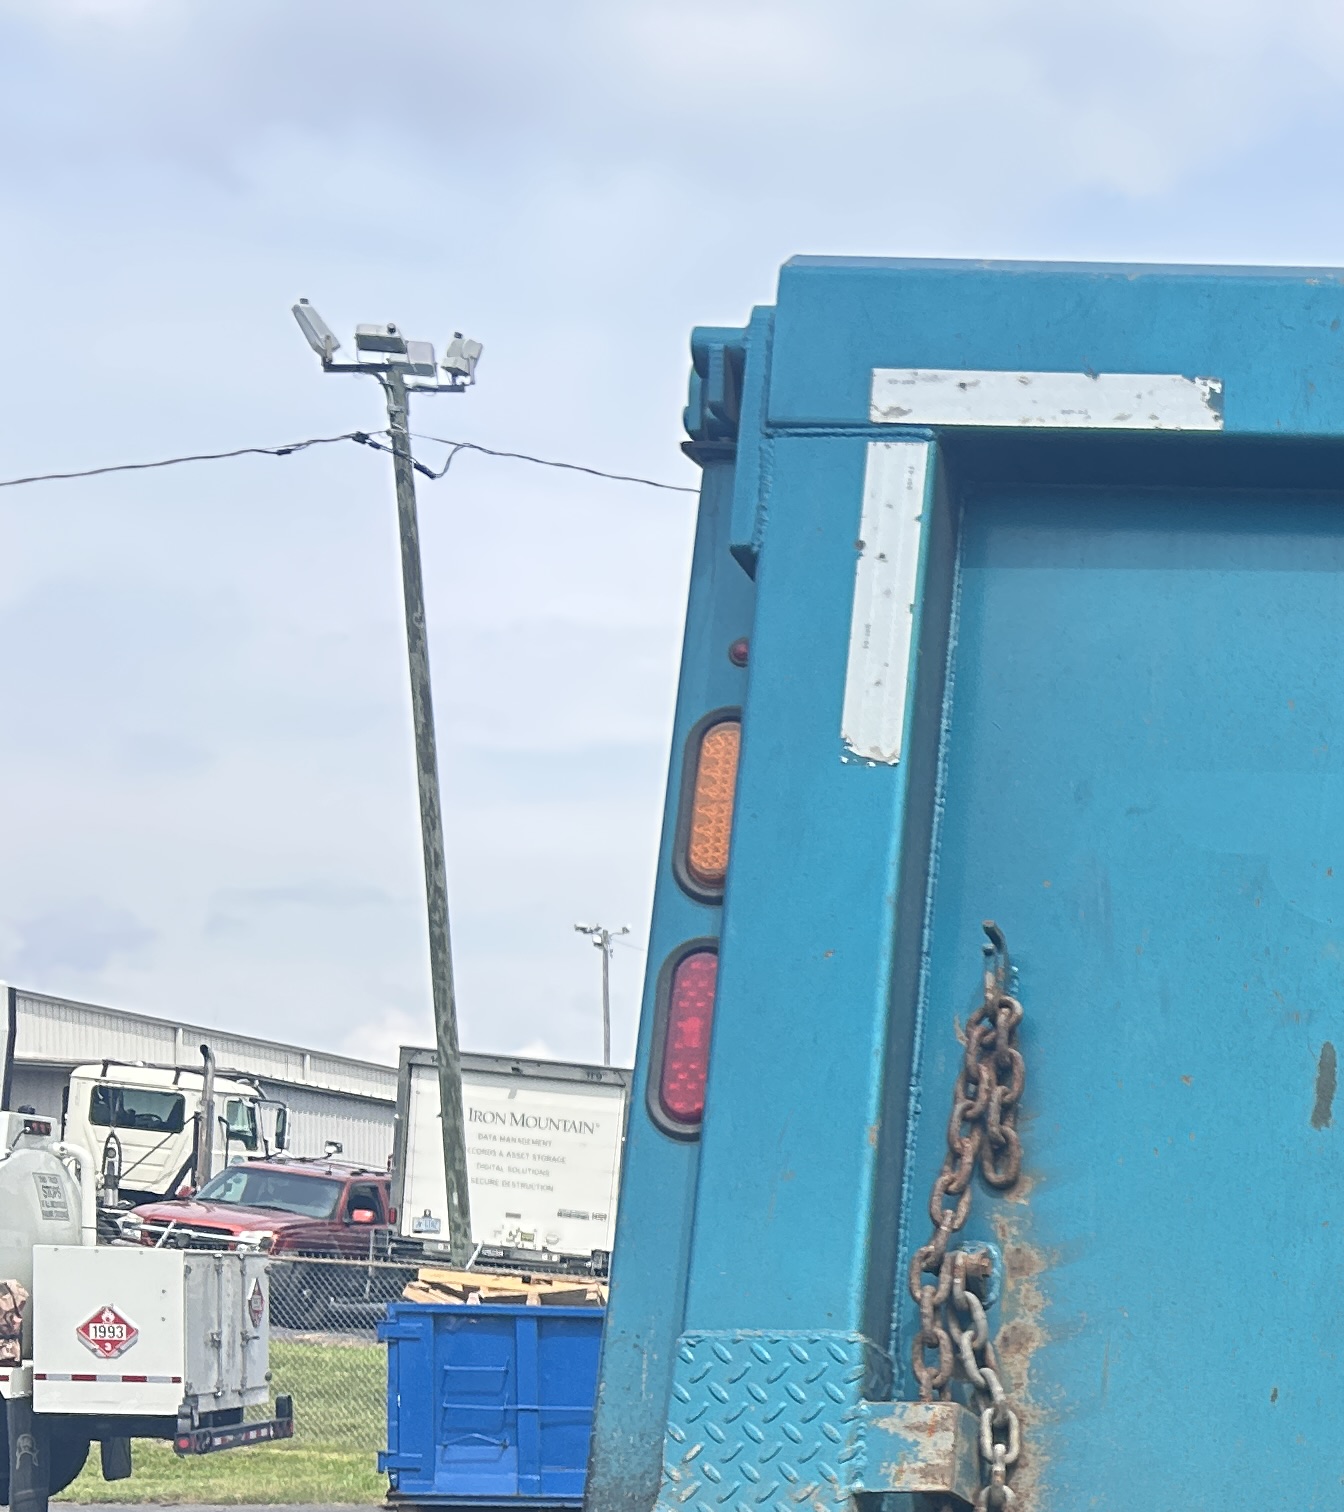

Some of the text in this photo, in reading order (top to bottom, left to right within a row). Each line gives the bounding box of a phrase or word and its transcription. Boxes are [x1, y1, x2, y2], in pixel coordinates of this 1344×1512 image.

[468, 1107, 596, 1135] IRON MOUNTAIN
[92, 1325, 124, 1339] 1993
